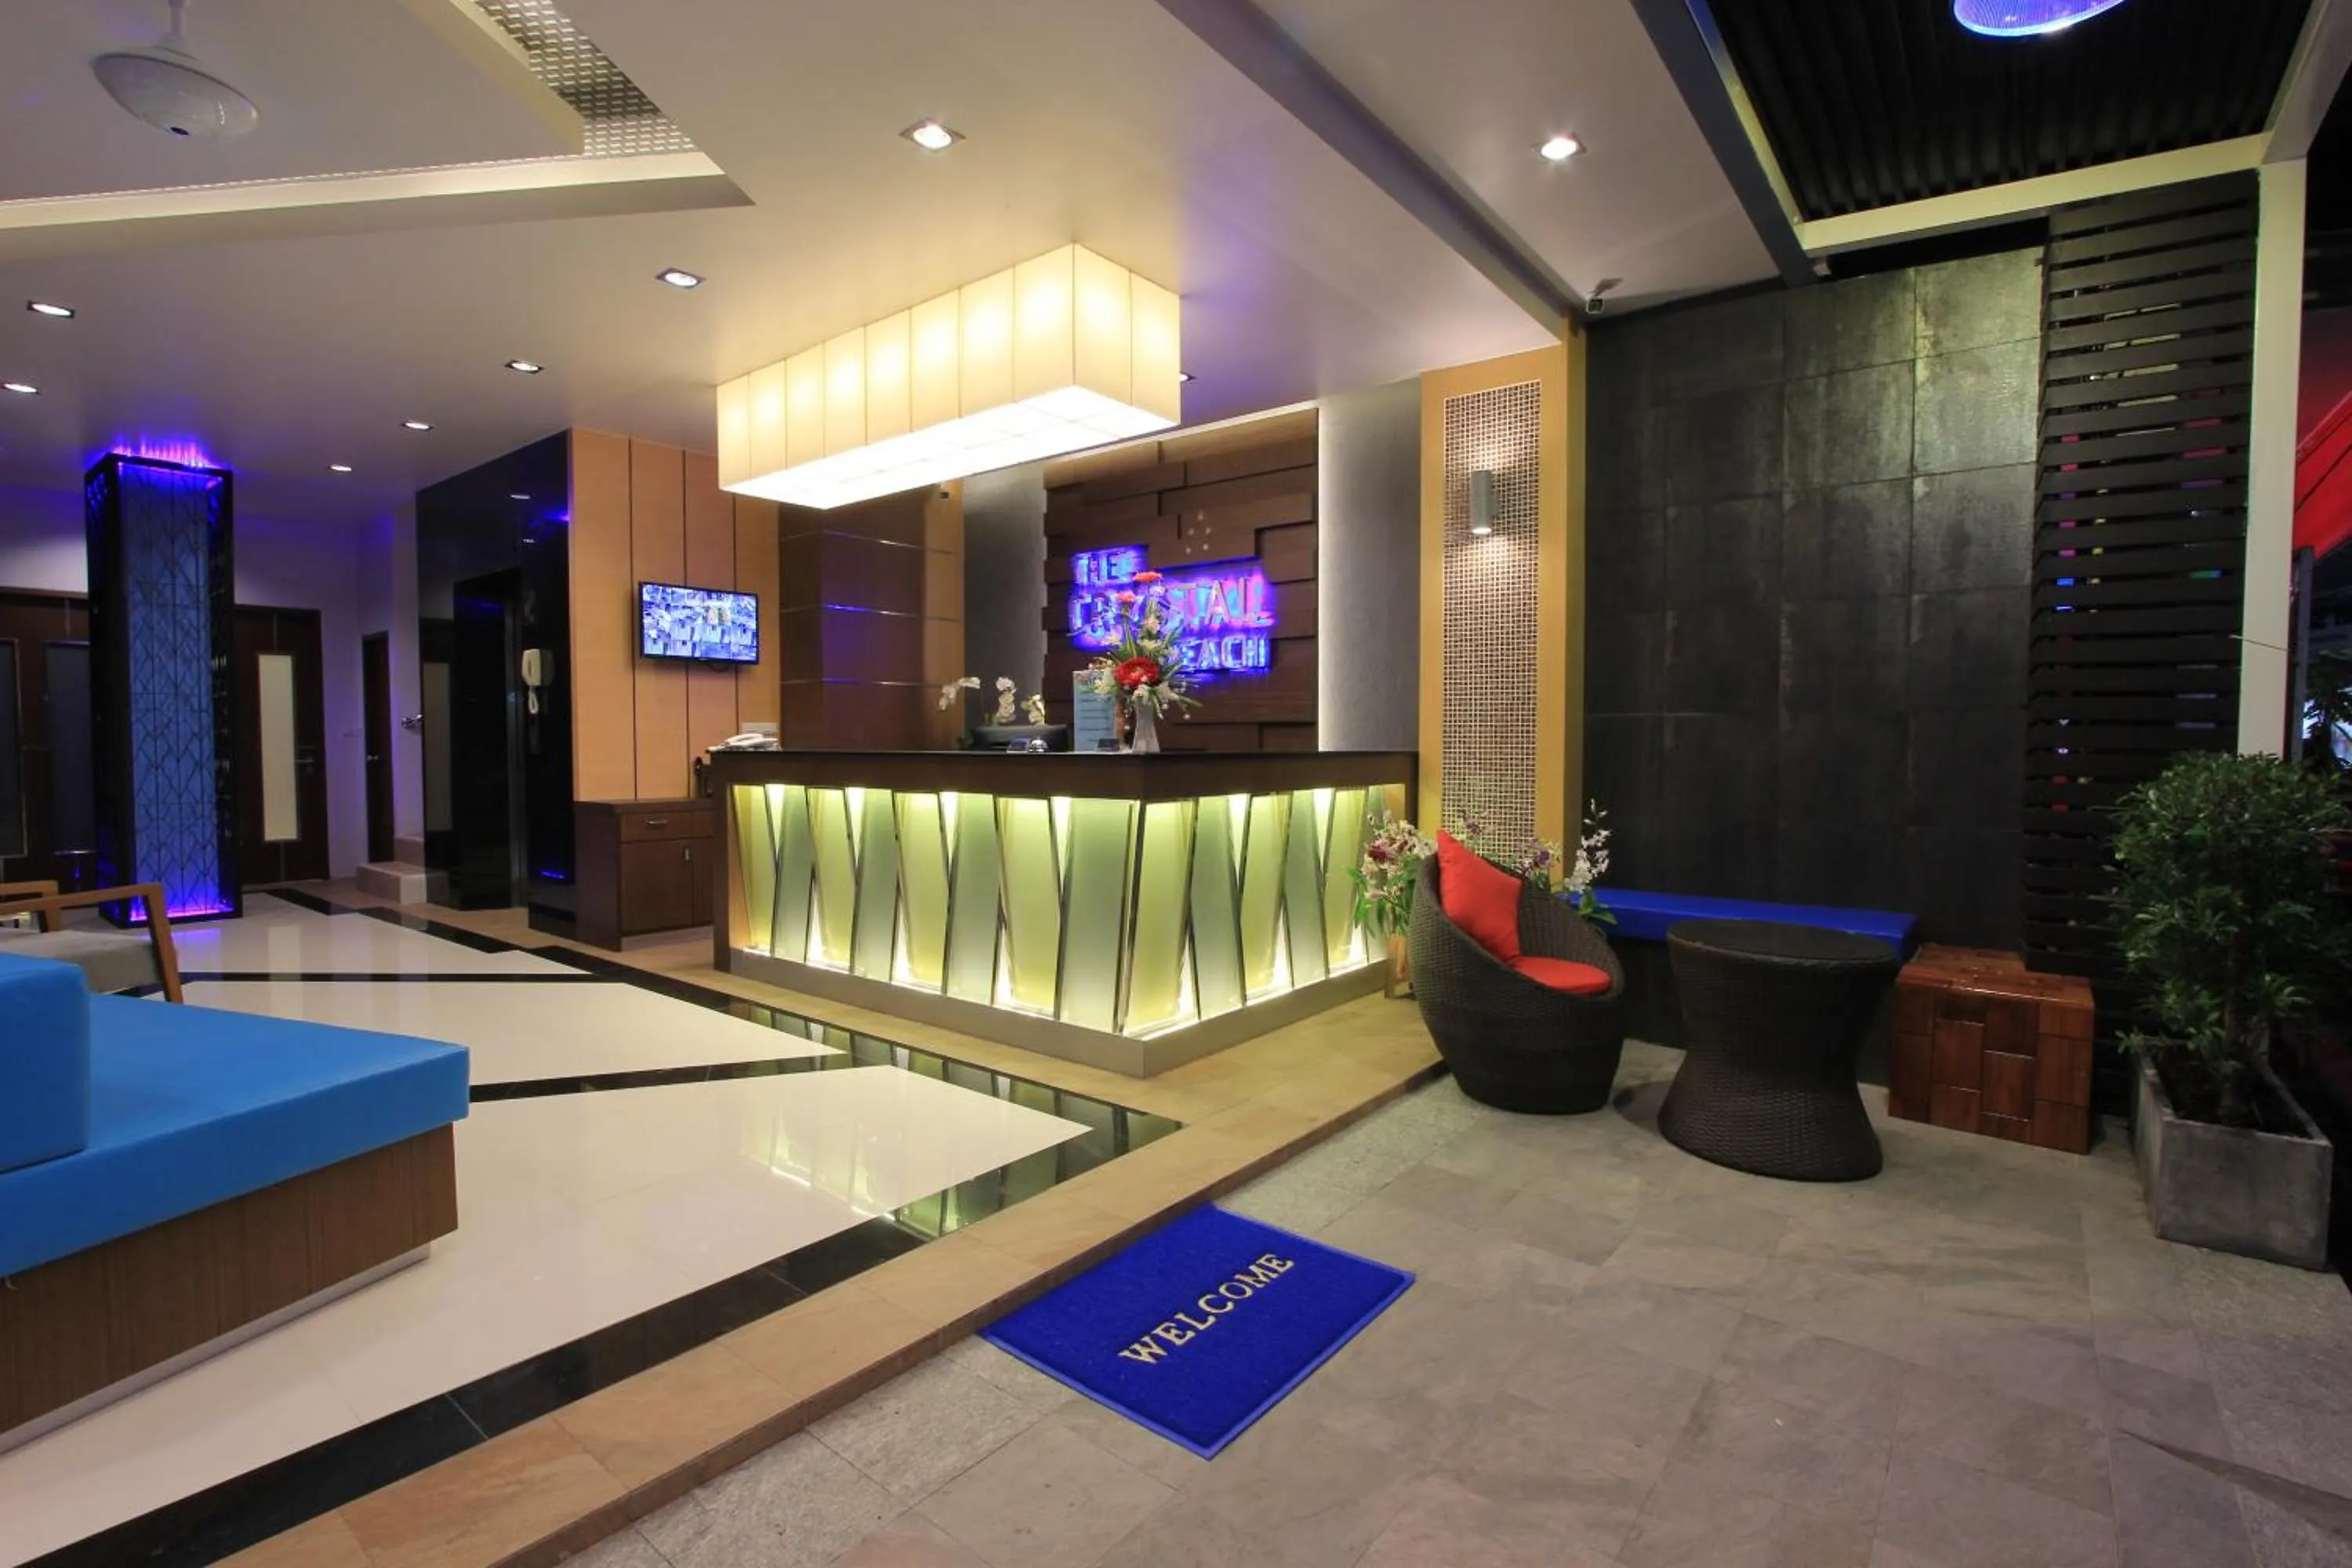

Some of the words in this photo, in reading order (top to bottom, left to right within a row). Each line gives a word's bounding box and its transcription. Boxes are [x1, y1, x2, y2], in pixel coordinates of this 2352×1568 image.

[1073, 550, 1131, 586] THE
[1174, 634, 1261, 670] EACH
[1118, 1254, 1294, 1363] WELCOME
